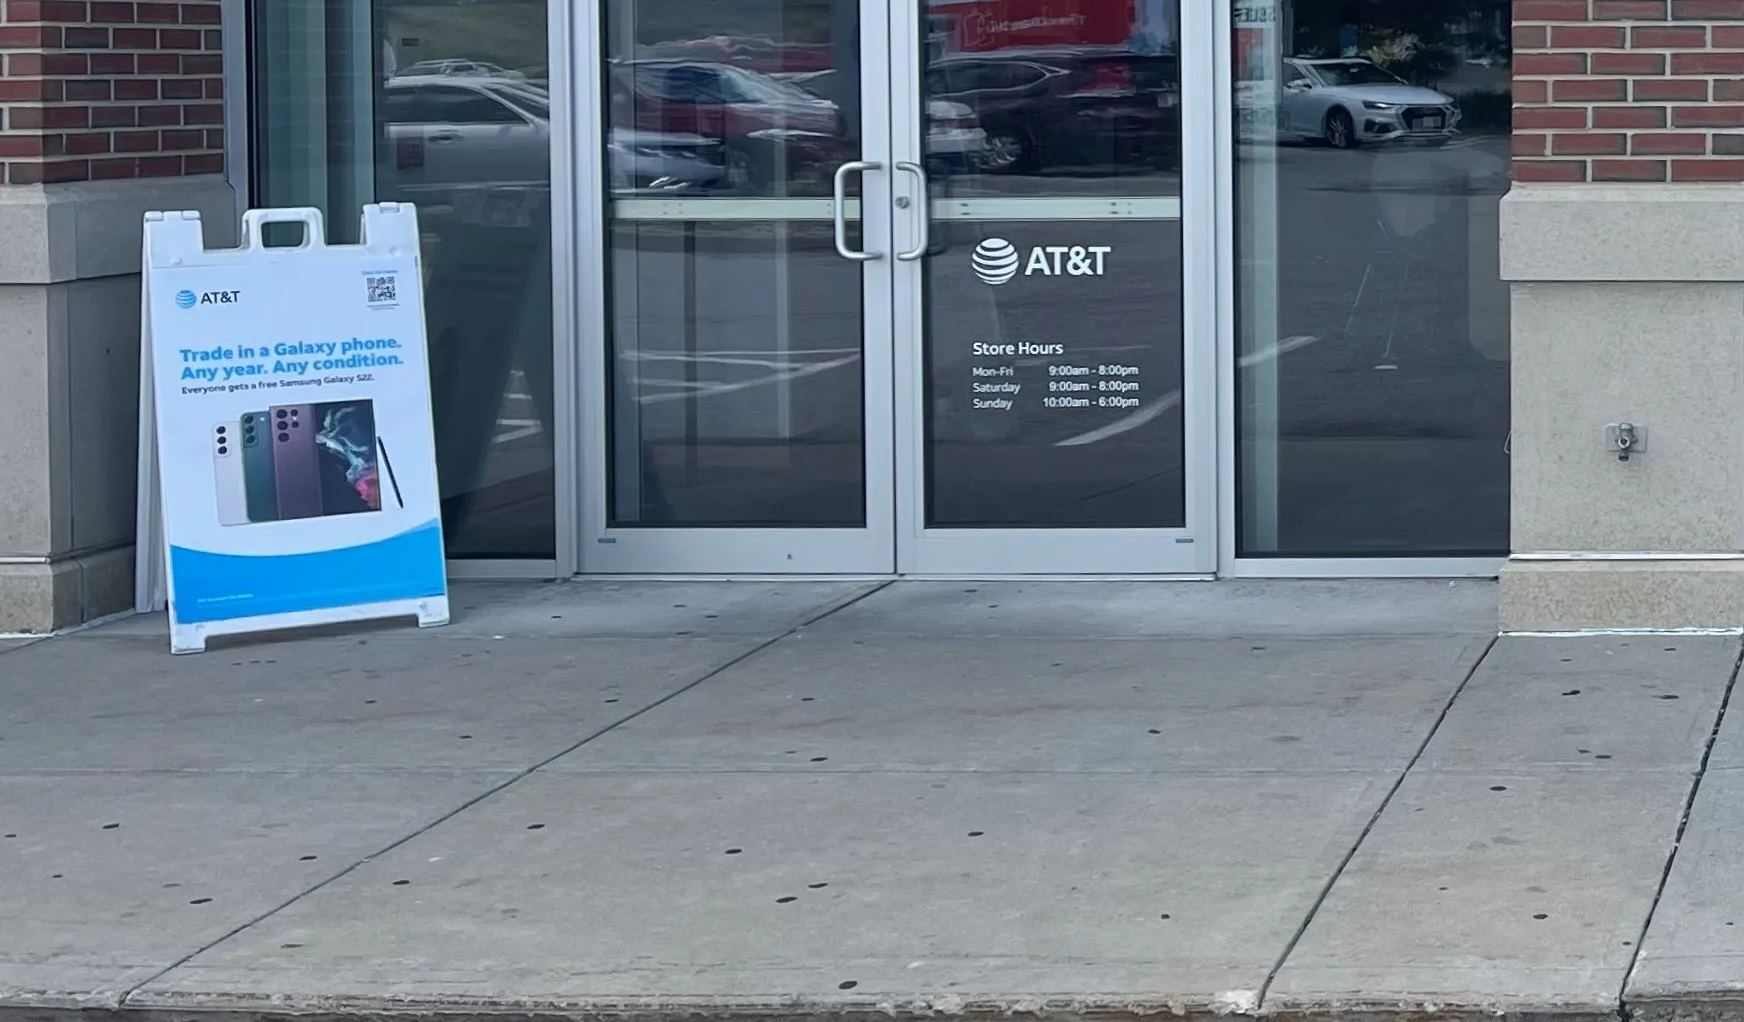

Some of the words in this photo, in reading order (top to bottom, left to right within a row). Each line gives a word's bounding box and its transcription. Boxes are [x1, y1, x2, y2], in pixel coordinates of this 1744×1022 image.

[1025, 246, 1111, 276] AT&T
[200, 290, 240, 306] AT&T
[179, 346, 233, 362] Trade
[238, 344, 255, 359] in
[259, 345, 270, 357] a
[274, 341, 337, 356] Galaxy
[341, 337, 402, 355] phone.
[973, 342, 1015, 356] Store
[1018, 342, 1064, 355] Hours
[181, 366, 218, 382] Any
[223, 363, 268, 381] year.
[272, 360, 309, 376] Any
[313, 353, 404, 371] condition.
[972, 366, 1013, 377] Mon-Fri
[1049, 365, 1089, 376] 9:00am
[1098, 365, 1139, 376] 8:00pm
[182, 384, 227, 395] Everyone
[229, 381, 249, 392] gets
[258, 380, 278, 389] free
[280, 378, 322, 388] Samsung
[324, 375, 354, 384] Galaxy
[972, 382, 1020, 394] Saturday
[1049, 381, 1089, 392] 9:00am
[1098, 381, 1139, 393] 8:00pm
[972, 398, 1012, 410] Sunday
[1042, 397, 1089, 408] 10:00am
[1098, 397, 1139, 409] 6:00pm
